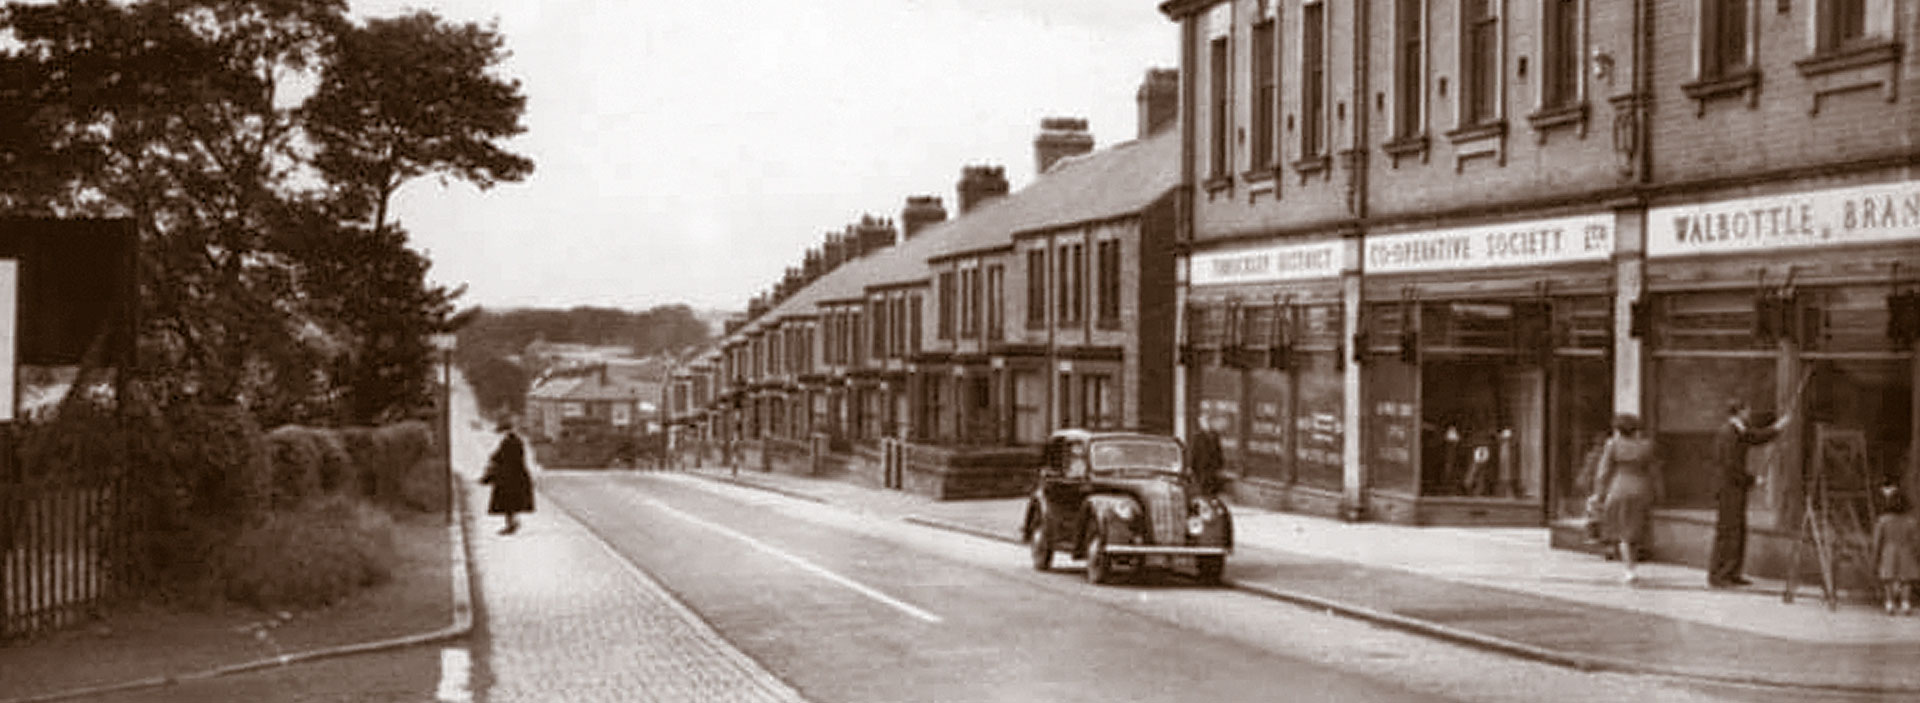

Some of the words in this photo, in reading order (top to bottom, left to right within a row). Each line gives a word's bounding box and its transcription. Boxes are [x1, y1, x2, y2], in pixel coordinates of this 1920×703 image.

[1843, 192, 1920, 231] BRAN
[1369, 235, 1470, 268] CO-OPERATIVE
[1486, 228, 1565, 257] SOCIETY
